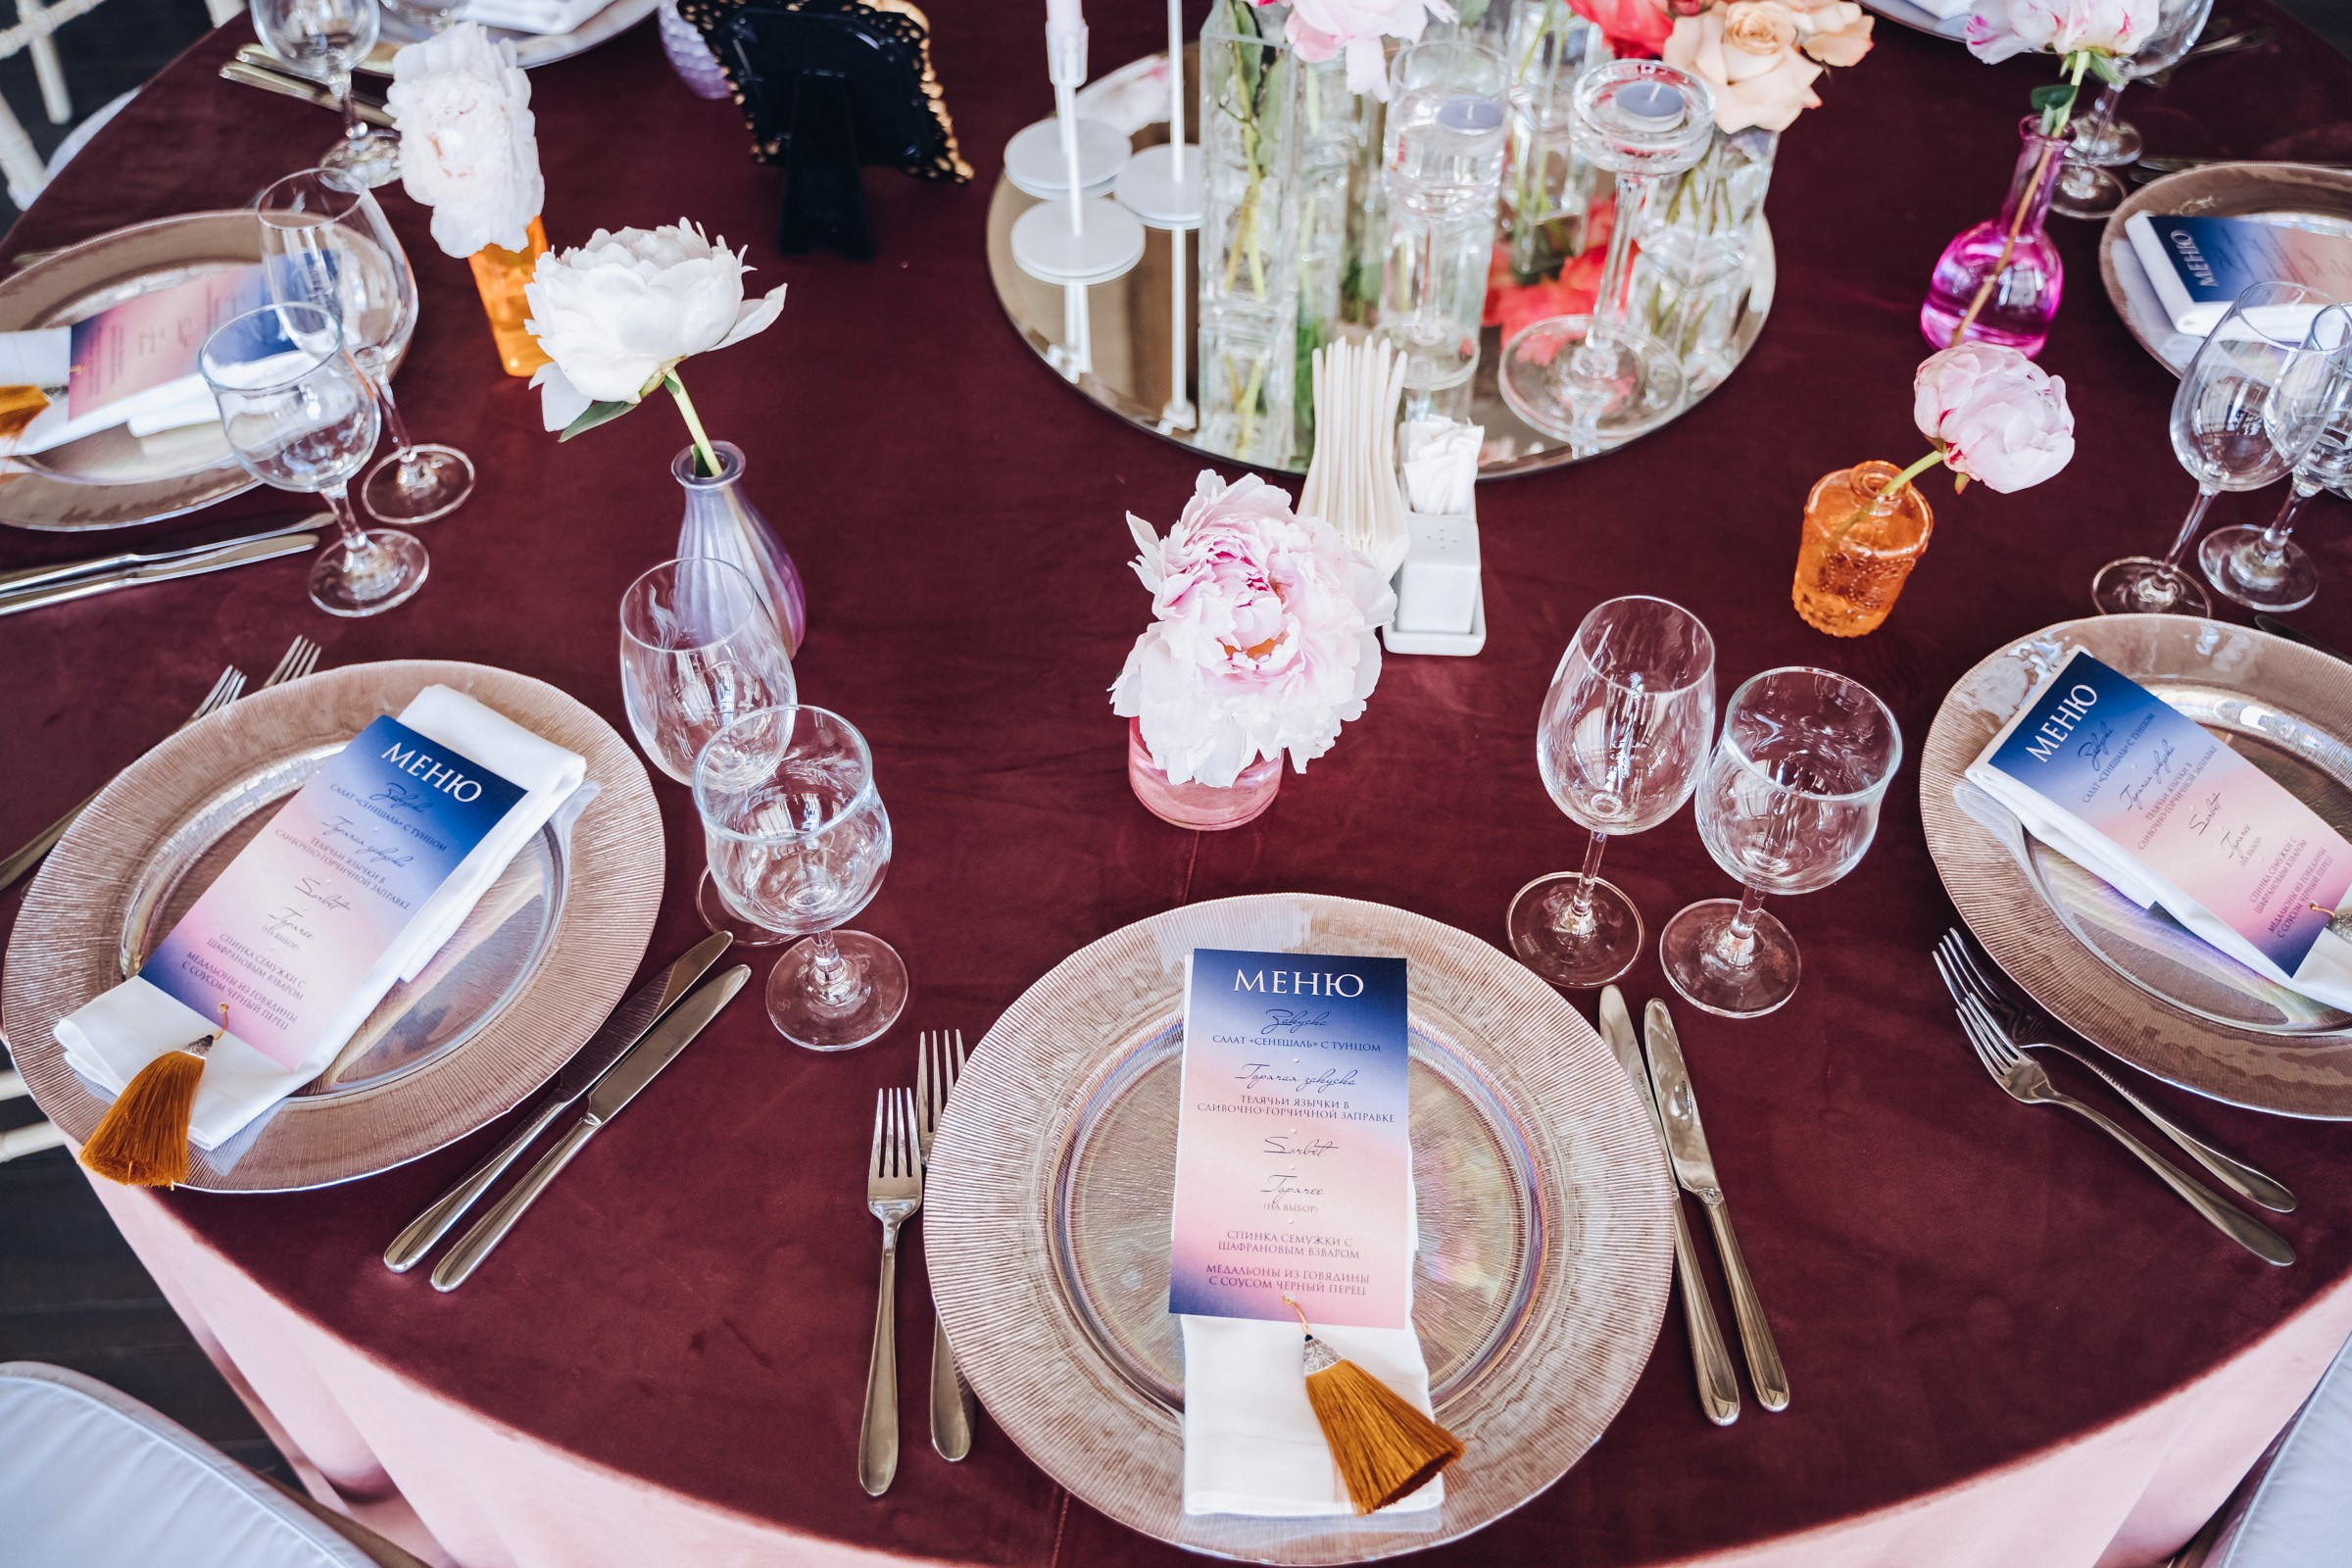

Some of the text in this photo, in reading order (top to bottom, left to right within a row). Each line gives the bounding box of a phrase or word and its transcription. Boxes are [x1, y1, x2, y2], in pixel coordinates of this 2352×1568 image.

[2170, 229, 2219, 287] МЕНЮ
[2025, 684, 2098, 763] МЕНЮ
[381, 742, 482, 803] МЕНЮ
[189, 965, 226, 993] СОУСОМ
[1234, 968, 1364, 998] МЕНЮ
[1212, 1035, 1381, 1052] САЛАТ «СЕНЕШАЛЬ» С ТУНЦОМ
[1241, 1095, 1349, 1109] ТЕЛЯЧЬИ ЯЗЫЧКИ В
[1197, 1103, 1395, 1123] СЛИВОЧНО-ГОРЧИЧНОЙ ЗАПРАВКЕ
[1226, 1230, 1351, 1248] СПИНКА СЕМУЖКИ С
[1218, 1241, 1359, 1259] ШАФРАНОВЫМ ВЗВАРОМ
[1205, 1264, 1369, 1284] МЕДАЛЬОНЫ ИЗ ГОВЯДИНЫ
[1208, 1275, 1366, 1296] С СОУСОМ ЧЕРНЫЙ ПЕРЕЦ
